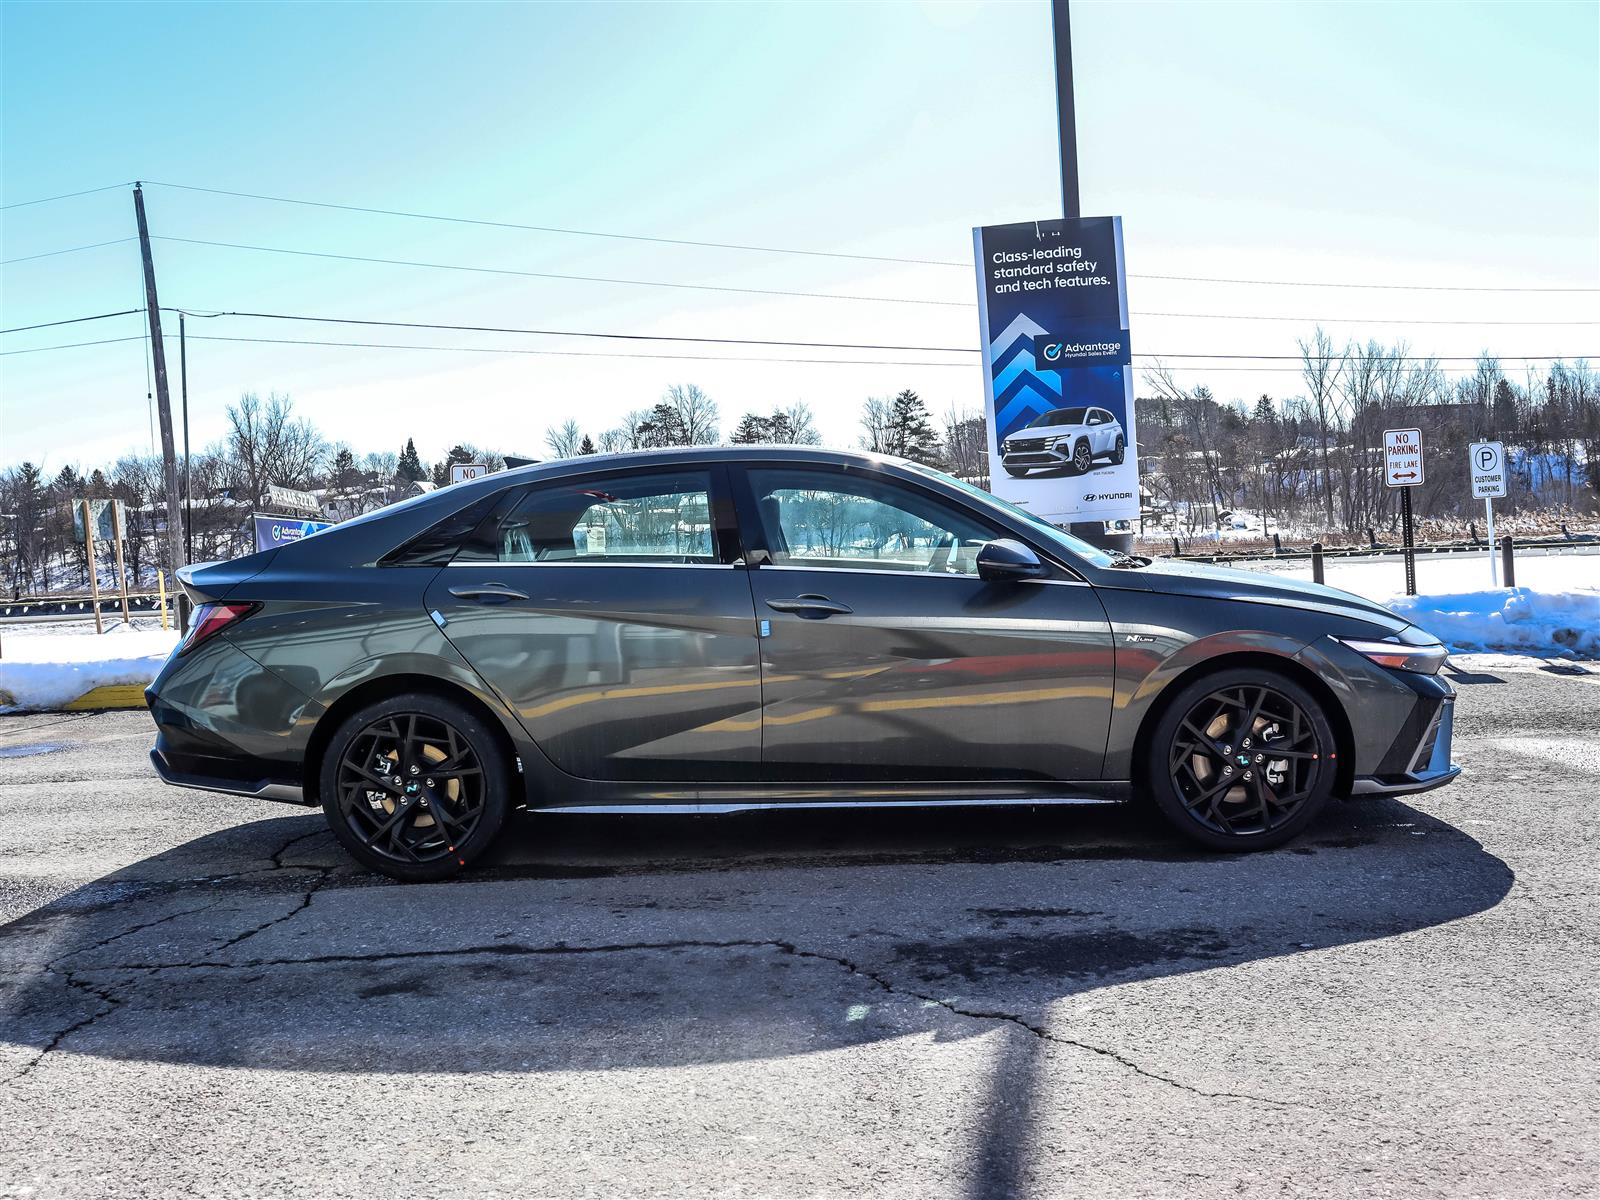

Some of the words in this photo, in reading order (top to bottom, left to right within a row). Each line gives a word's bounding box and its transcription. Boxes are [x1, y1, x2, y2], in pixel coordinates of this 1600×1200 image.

[993, 246, 1082, 264] Class-leading
[994, 262, 1053, 278] standard
[1057, 260, 1097, 274] safety
[995, 280, 1020, 294] and
[1023, 278, 1050, 290] tech
[1054, 276, 1111, 288] features.
[1065, 342, 1120, 352] Advantage
[1396, 434, 1408, 444] NO
[1388, 444, 1418, 456] PARKING
[1390, 461, 1402, 469] FIRE
[1404, 460, 1418, 468] LANE
[1481, 452, 1492, 468] P
[463, 469, 476, 479] NO
[1474, 474, 1501, 482] CUSTOMER
[1478, 485, 1500, 493] PARKING
[1098, 492, 1132, 500] HYUNDAI
